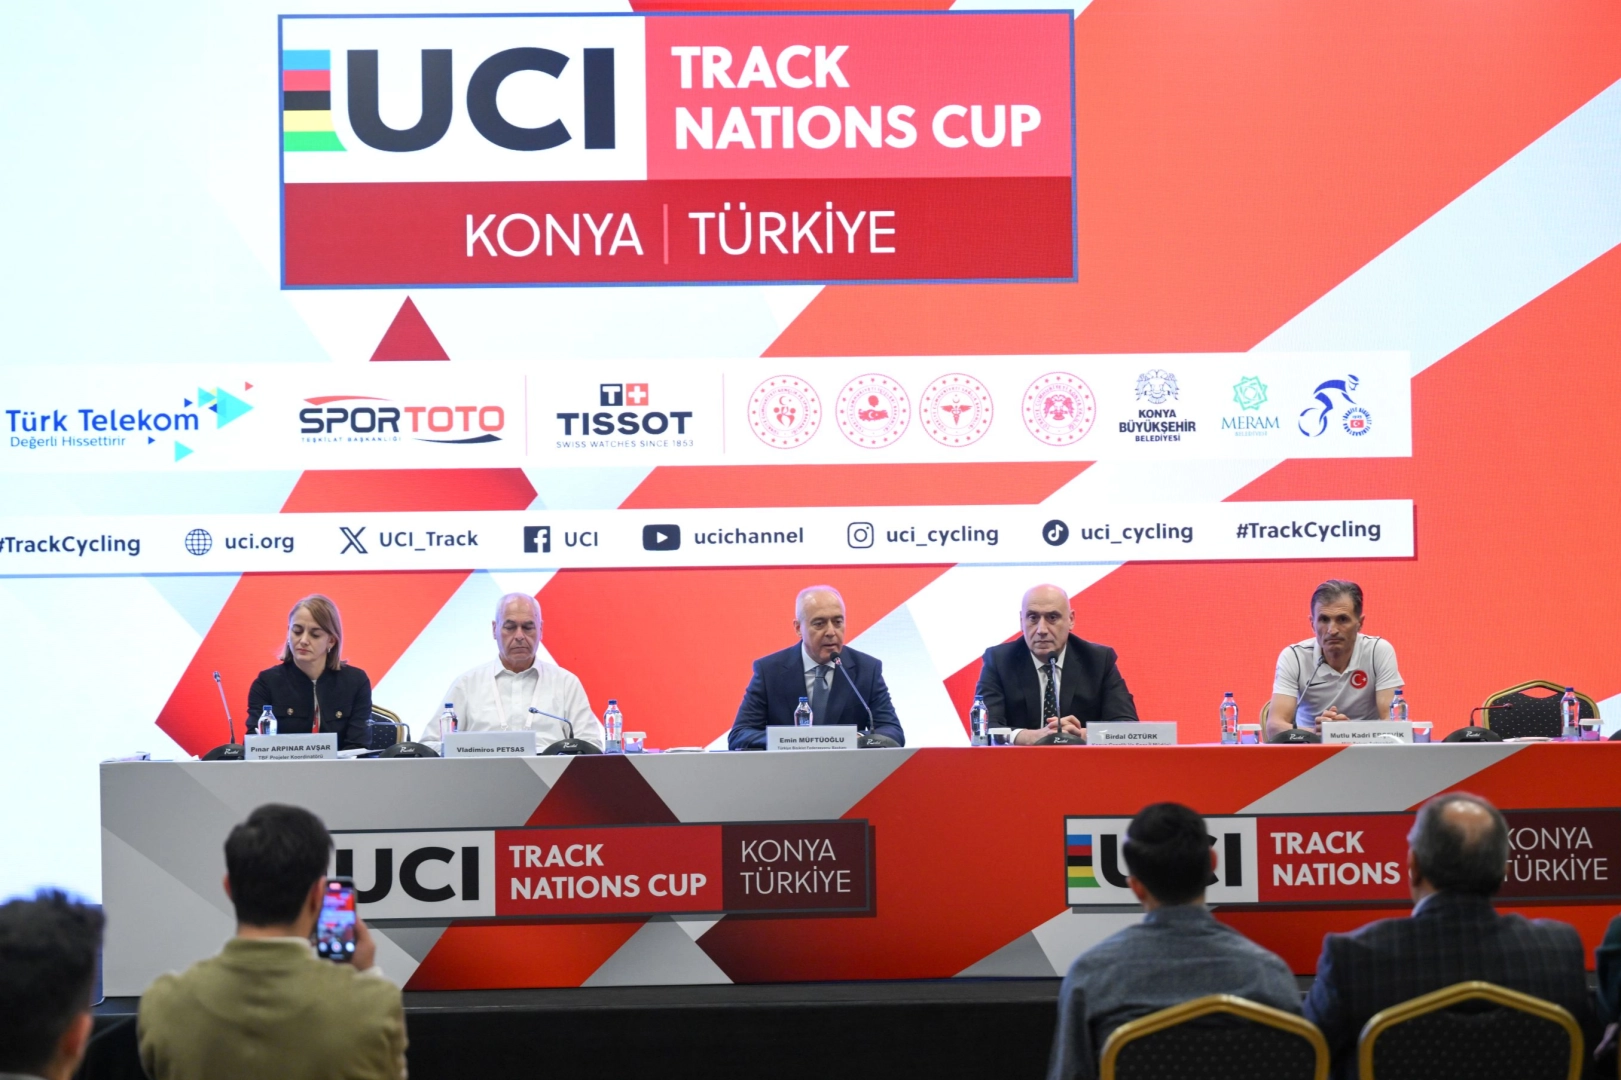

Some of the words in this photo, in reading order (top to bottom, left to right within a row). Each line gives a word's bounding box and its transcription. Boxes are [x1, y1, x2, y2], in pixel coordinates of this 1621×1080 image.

[671, 45, 849, 88] TRACK
[347, 46, 616, 153] UCI
[676, 105, 917, 149] NATIONS
[932, 105, 1041, 148] CUP
[466, 213, 643, 257] KONYA
[689, 202, 895, 255] TÜRKİYE
[6, 410, 67, 432] Türk
[78, 406, 198, 431] Telekom
[557, 412, 692, 435] TISSOT
[1138, 409, 1177, 418] KONYA
[1222, 416, 1279, 429] MERAM
[1118, 419, 1197, 434] BÜYÜKŞEHİR
[10, 436, 58, 449] Değerli
[62, 436, 126, 447] Hissettirir
[556, 440, 587, 449] SWISS
[589, 440, 637, 448] WATCHES
[639, 440, 669, 448] SINCE
[672, 439, 694, 447] 1853
[380, 530, 478, 551] UCI_Track
[565, 532, 597, 547] UCI
[695, 527, 803, 544] ucichannel
[887, 526, 998, 546] uci_cycling
[1082, 523, 1193, 544] uci_cycling
[1236, 521, 1380, 542] #TrackCycling
[226, 534, 293, 553] uci.org
[1127, 732, 1158, 740] ÖZTÜRK
[742, 839, 836, 862] KONYA
[1271, 831, 1364, 854] TRACK
[509, 844, 604, 867] TRACK
[336, 845, 479, 904] UCI
[740, 866, 850, 894] TÜRKİYE
[1271, 861, 1401, 888] NATIONS
[511, 875, 640, 899] NATIONS
[648, 873, 706, 896] CUP
